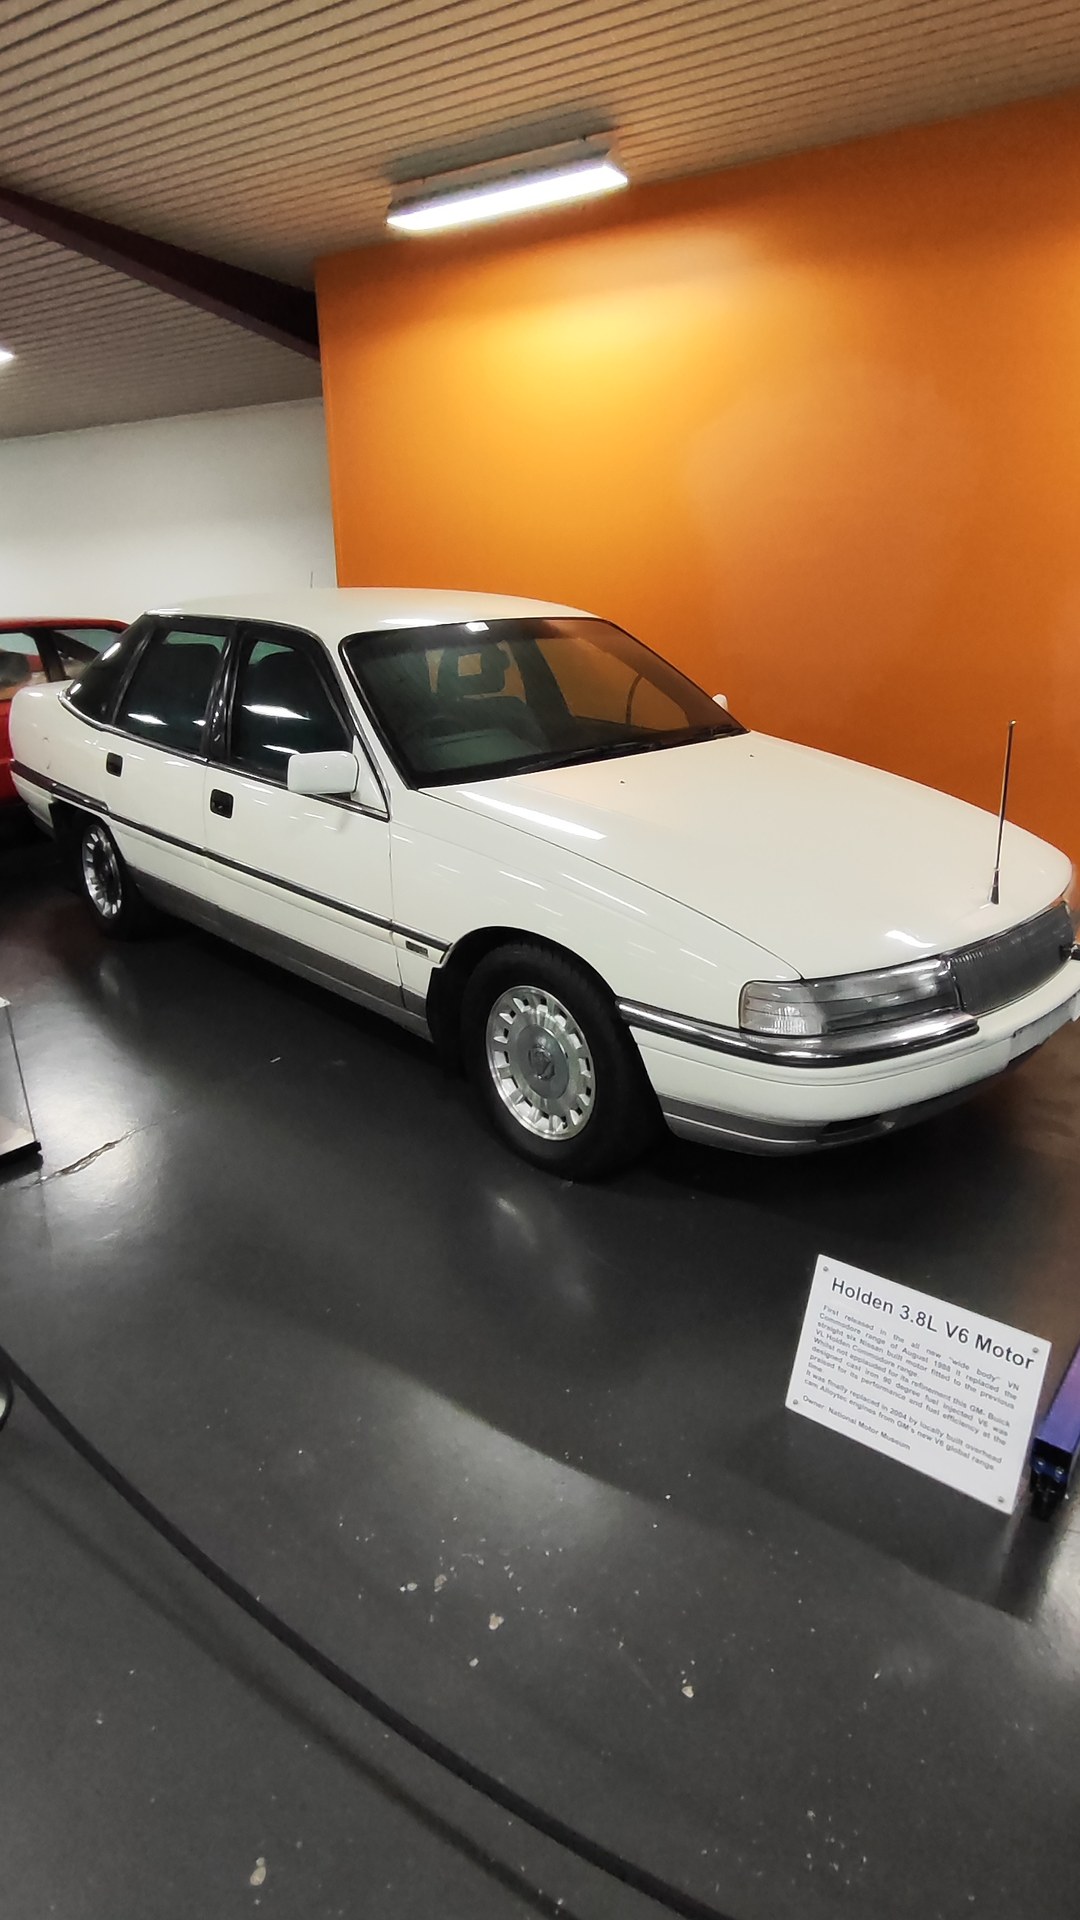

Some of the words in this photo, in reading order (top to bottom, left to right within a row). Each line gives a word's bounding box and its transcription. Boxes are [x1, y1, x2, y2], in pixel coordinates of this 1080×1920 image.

[815, 1328, 824, 1338] VL
[826, 1333, 851, 1348] Holden
[852, 1344, 895, 1368] Commodore
[817, 1321, 844, 1337] straight
[846, 1334, 857, 1342] six
[859, 1338, 884, 1353] Nissan
[886, 1349, 903, 1362] built
[905, 1359, 928, 1371] motor
[930, 1368, 951, 1382] fitted
[953, 1378, 962, 1387] to
[964, 1383, 977, 1393] the
[979, 1390, 1014, 1409] previous
[819, 1312, 861, 1335] Commodore
[865, 1332, 886, 1345] range
[901, 1347, 929, 1363] August
[965, 1375, 1000, 1393] replaced
[1004, 1390, 1017, 1401] the
[823, 1304, 839, 1317] First
[844, 1315, 875, 1331] released
[893, 1334, 905, 1344] the
[910, 1342, 920, 1350] all
[926, 1349, 942, 1359] new
[1007, 1381, 1020, 1391] VN
[832, 1277, 893, 1314] Holden
[899, 1304, 937, 1333] 3.8L
[946, 1321, 970, 1344] V6
[975, 1334, 1034, 1369] Motor
[804, 1379, 819, 1389] cam
[848, 1399, 877, 1416] engines
[878, 1411, 895, 1424] from
[917, 1430, 933, 1441] new
[934, 1437, 944, 1447] V6
[945, 1444, 970, 1459] global
[809, 1354, 835, 1369] praised
[837, 1365, 847, 1374] for
[849, 1371, 858, 1380] its
[860, 1377, 906, 1401] performance
[908, 1398, 923, 1408] and
[925, 1404, 940, 1416] fuel
[942, 1413, 979, 1434] efficiency
[982, 1431, 991, 1439] at
[993, 1435, 1006, 1446] the
[811, 1346, 843, 1363] designed
[846, 1361, 862, 1372] cast
[865, 1368, 879, 1379] iron
[883, 1376, 892, 1385] 90
[895, 1382, 921, 1397] degree
[925, 1394, 939, 1405] fuel
[943, 1403, 974, 1421] injected
[977, 1418, 988, 1427] V6
[992, 1426, 1008, 1437] was
[812, 1374, 826, 1383] was
[827, 1379, 848, 1394] finally
[849, 1390, 880, 1408] replaced
[881, 1404, 889, 1412] in
[889, 1407, 907, 1420] 2004
[908, 1415, 918, 1426] by
[919, 1421, 945, 1438] locally
[946, 1433, 964, 1446] built
[965, 1443, 1002, 1464] overhead
[813, 1337, 835, 1351] Whilst
[836, 1348, 848, 1357] not
[849, 1354, 887, 1373] applauded
[888, 1369, 899, 1378] for
[900, 1374, 909, 1384] its
[911, 1380, 951, 1402] refinement
[952, 1397, 967, 1409] this
[987, 1412, 1010, 1427] Buick
[828, 1406, 857, 1425] National
[858, 1420, 879, 1435] Motor
[880, 1431, 911, 1450] Museum
